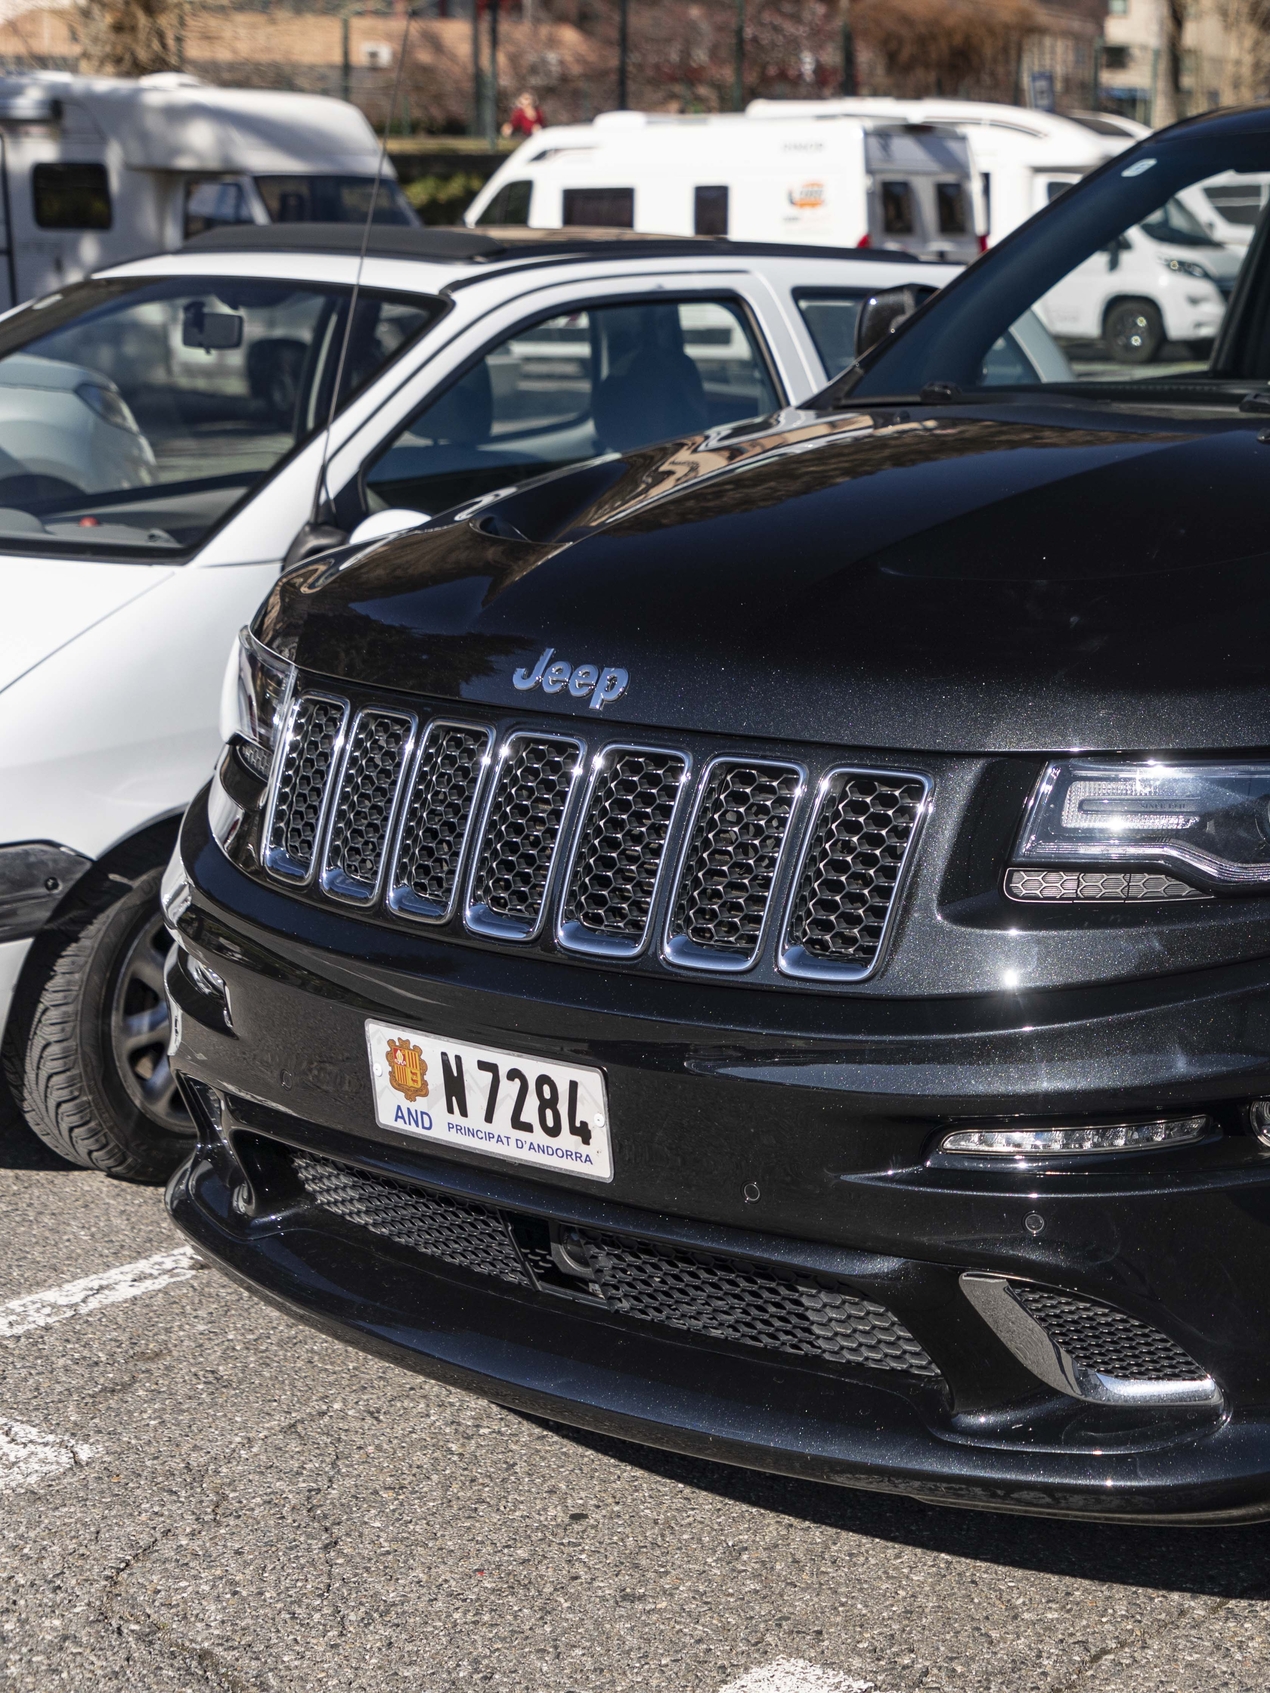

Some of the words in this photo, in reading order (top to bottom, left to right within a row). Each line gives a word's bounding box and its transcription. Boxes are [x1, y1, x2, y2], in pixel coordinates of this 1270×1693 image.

[512, 648, 630, 711] Jeep
[393, 1104, 433, 1132] AND
[440, 1051, 469, 1119] N
[477, 1059, 593, 1146] 7284
[447, 1122, 512, 1147] PRINCIPAT
[515, 1138, 594, 1166] D'ANDORRA
